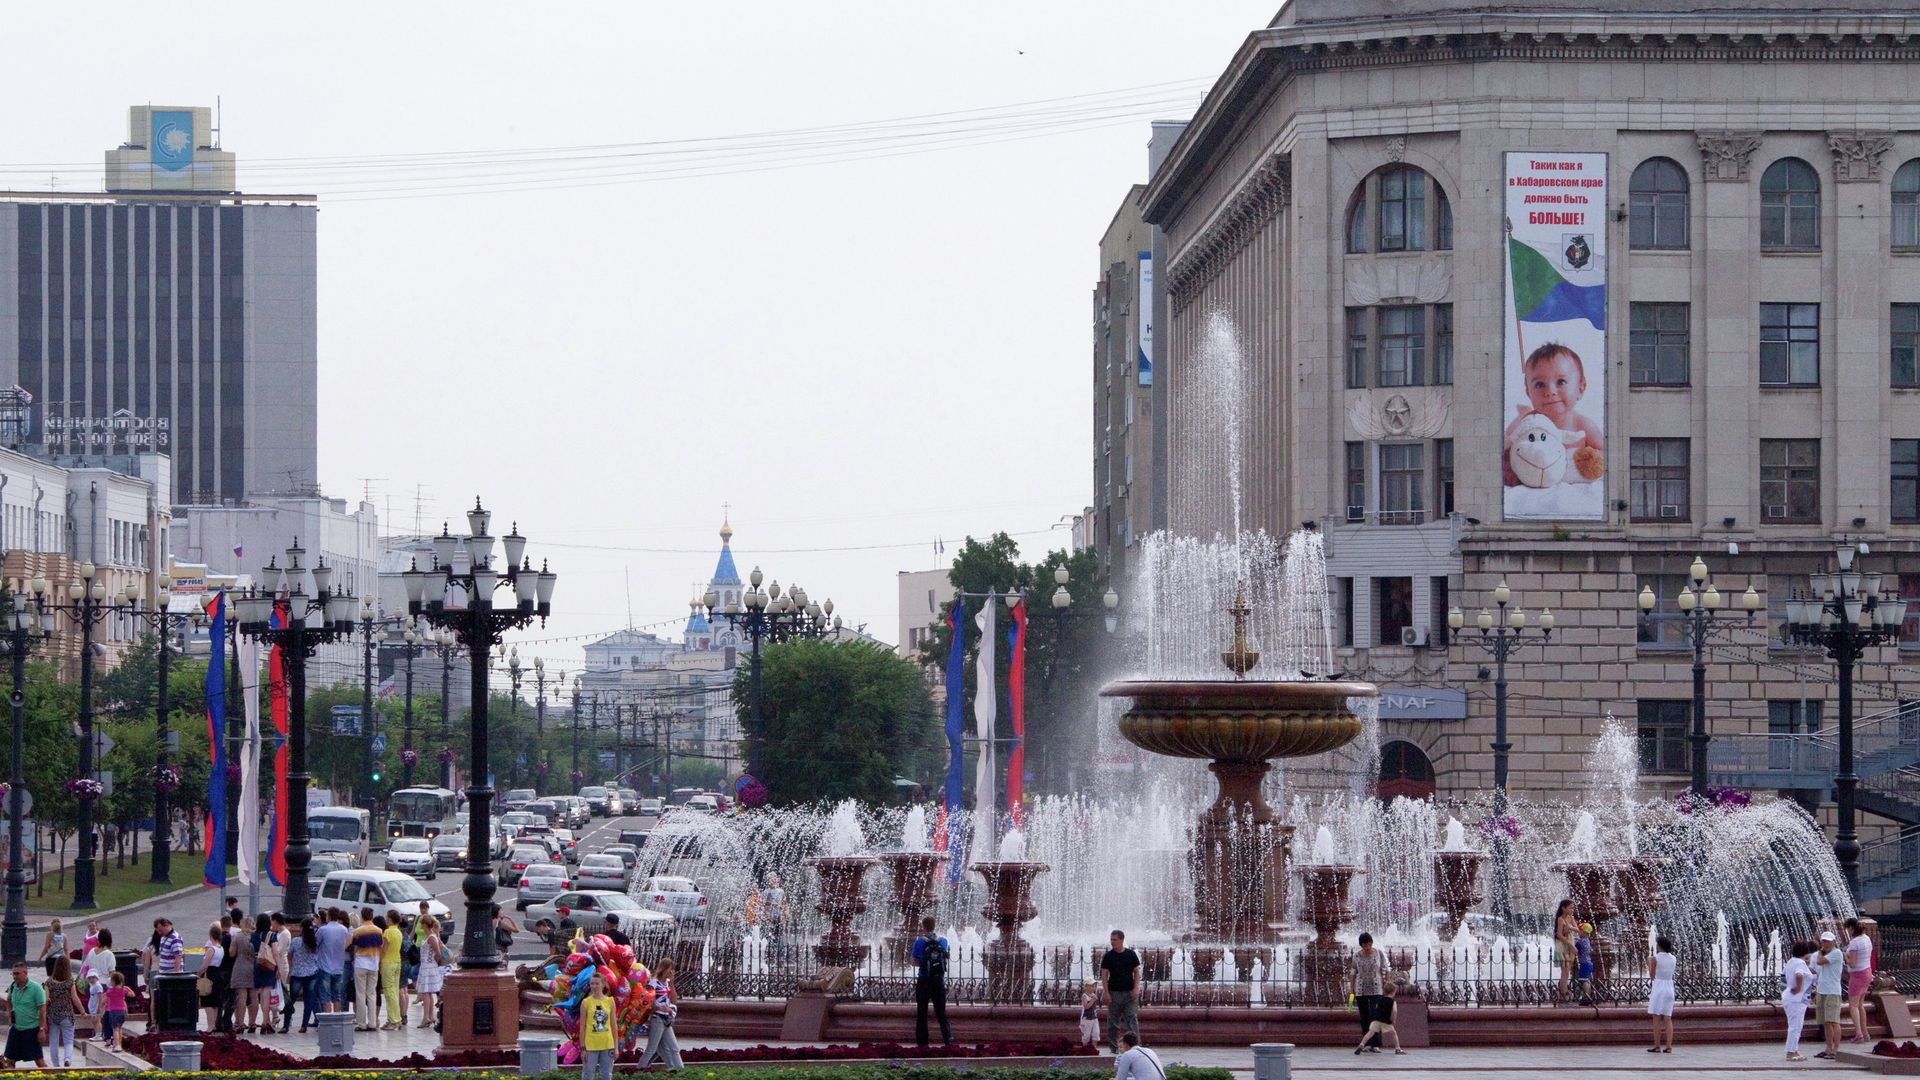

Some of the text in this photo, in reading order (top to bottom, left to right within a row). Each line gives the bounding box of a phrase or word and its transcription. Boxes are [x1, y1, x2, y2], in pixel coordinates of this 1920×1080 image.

[1530, 160, 1583, 170] Таких как я
[1509, 177, 1603, 188] в Хабаровском крае
[1524, 194, 1588, 204] должно быть
[1529, 211, 1585, 225] БОЛЬШЕ!
